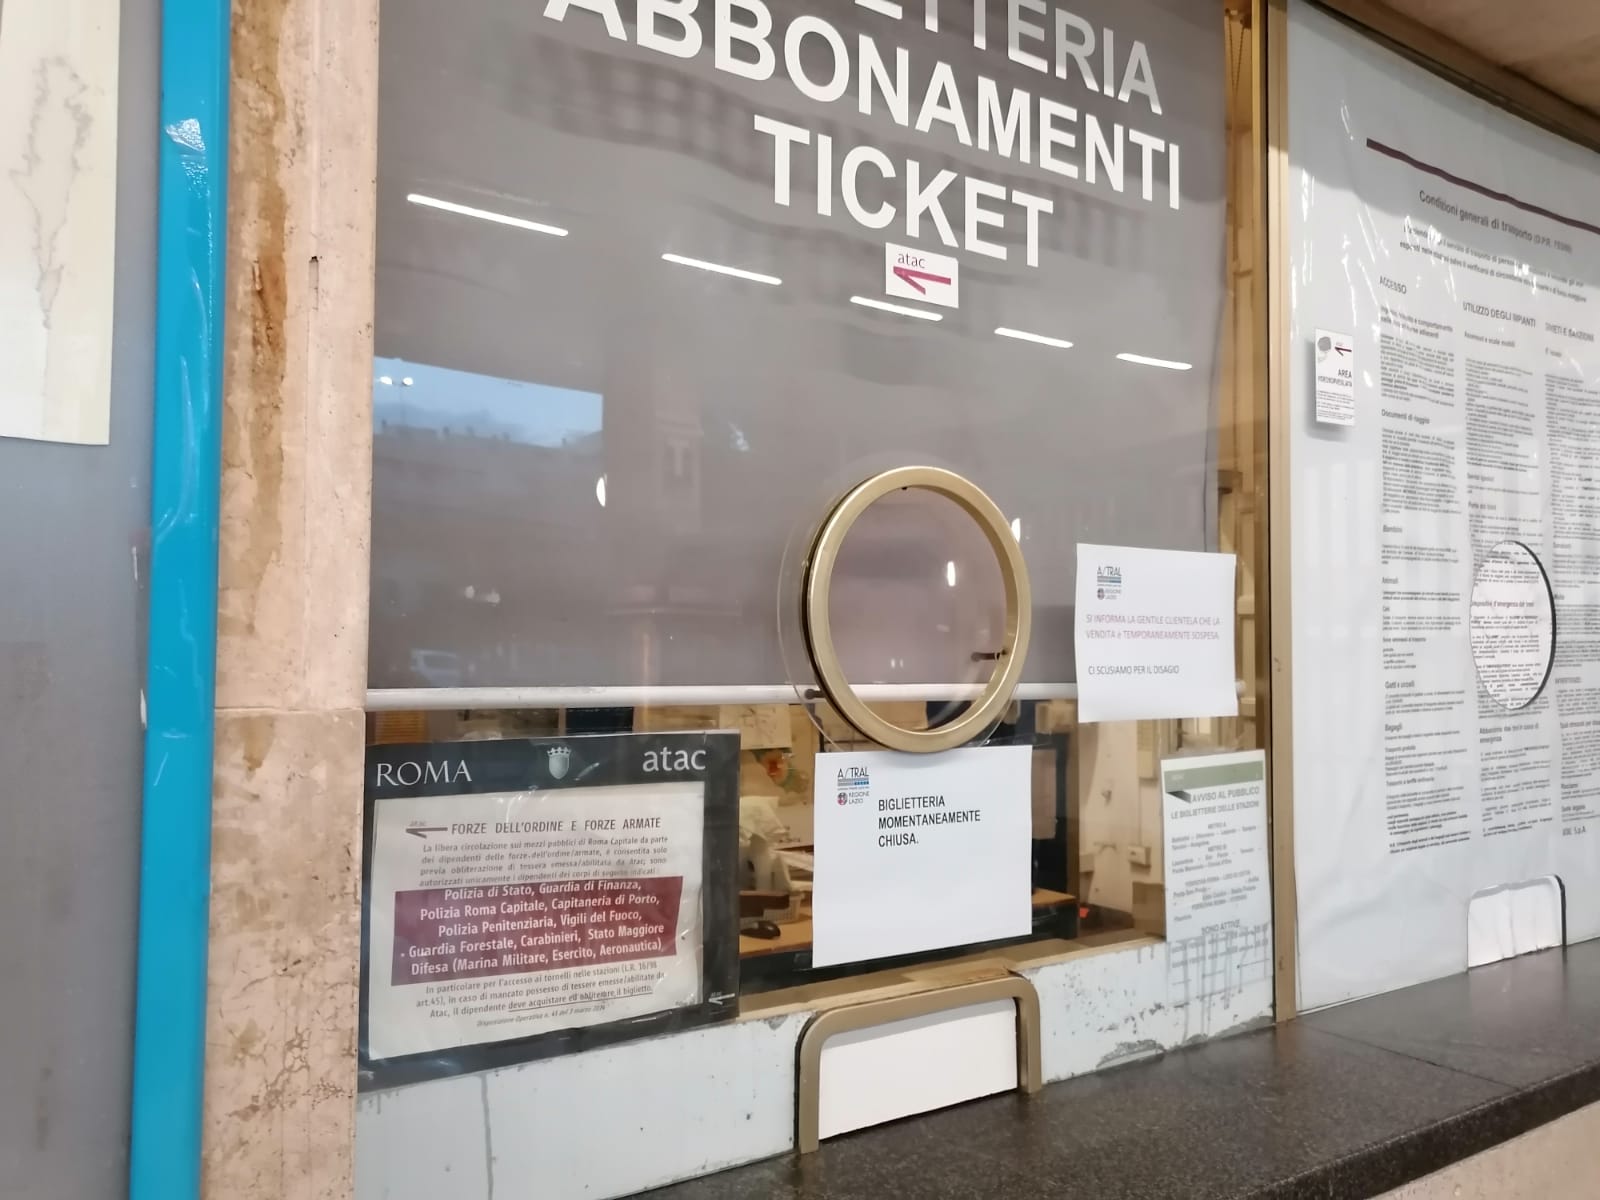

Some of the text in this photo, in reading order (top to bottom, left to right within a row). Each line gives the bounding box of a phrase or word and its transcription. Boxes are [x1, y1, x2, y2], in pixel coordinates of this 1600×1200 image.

[754, 114, 1054, 267] TICKET
[898, 253, 925, 269] atac
[1490, 309, 1511, 320] DEGLI
[1086, 614, 1220, 626] SI INFORMA LA GENTILE CLIENTELA CHE LA
[1086, 630, 1115, 639] VENDITA
[1123, 630, 1190, 640] TEMPORANEAMENTE
[1088, 664, 1179, 675] CI SCUSIAMO PER IL DISAGIO
[643, 746, 706, 772] atac
[375, 759, 473, 787] ROMA
[878, 795, 945, 811] BIGLIETTERIA
[451, 817, 661, 835] FORZE DELL'ORDINE E FORZE ARMATE
[878, 810, 981, 829] MOMENTANEAMENTE
[435, 844, 458, 852] libera
[461, 842, 507, 851] circolazione
[510, 841, 521, 849] sui
[524, 840, 545, 849] mezzi
[548, 839, 576, 849] pubblici
[578, 838, 585, 846] di
[588, 838, 608, 846] Roma
[610, 836, 638, 847] Capitale
[640, 835, 648, 844] da
[650, 835, 668, 845] parte
[878, 833, 919, 847] CHIUSA.
[422, 856, 434, 864] dei
[438, 855, 481, 865] dipendenti
[485, 853, 504, 862] delle
[420, 866, 446, 876] previa
[451, 863, 503, 874] obliterazione
[507, 863, 515, 871] di
[519, 861, 546, 870] tessera
[419, 877, 463, 887] autorizzati
[465, 875, 511, 884] unicamente
[518, 871, 557, 882] dipendenti
[559, 870, 570, 878] dei
[572, 869, 590, 879] corpi
[445, 879, 641, 900] Polizia di Stato, Guardia di Finanza,
[420, 894, 660, 920] Polizia Roma Capitale, Capitaneria di Porto,
[438, 910, 642, 937] Polizia Penitenziaria, Vigili del Fuoco,
[409, 923, 664, 958] Guardia Forestale, Carabinieri, Stato Maggiore
[411, 962, 448, 975] Difesa
[452, 957, 498, 972] (Marina
[502, 953, 548, 967] Militare,
[552, 946, 596, 961] Esercito,
[426, 986, 434, 994] In
[436, 982, 480, 994] particolare
[483, 980, 496, 990] per
[534, 975, 541, 983] ai
[544, 971, 571, 982] tornelli
[573, 968, 591, 979] nelle
[592, 965, 620, 977] stazioni
[448, 996, 457, 1004] in
[458, 994, 477, 1003] caso
[480, 992, 487, 1001] di
[490, 989, 523, 999] mancato
[526, 985, 559, 996] possesso
[561, 982, 569, 991] di
[571, 980, 596, 990] tessere
[461, 1004, 506, 1016] dipendente
[508, 1001, 526, 1010] deve
[528, 995, 566, 1007] acquistare
